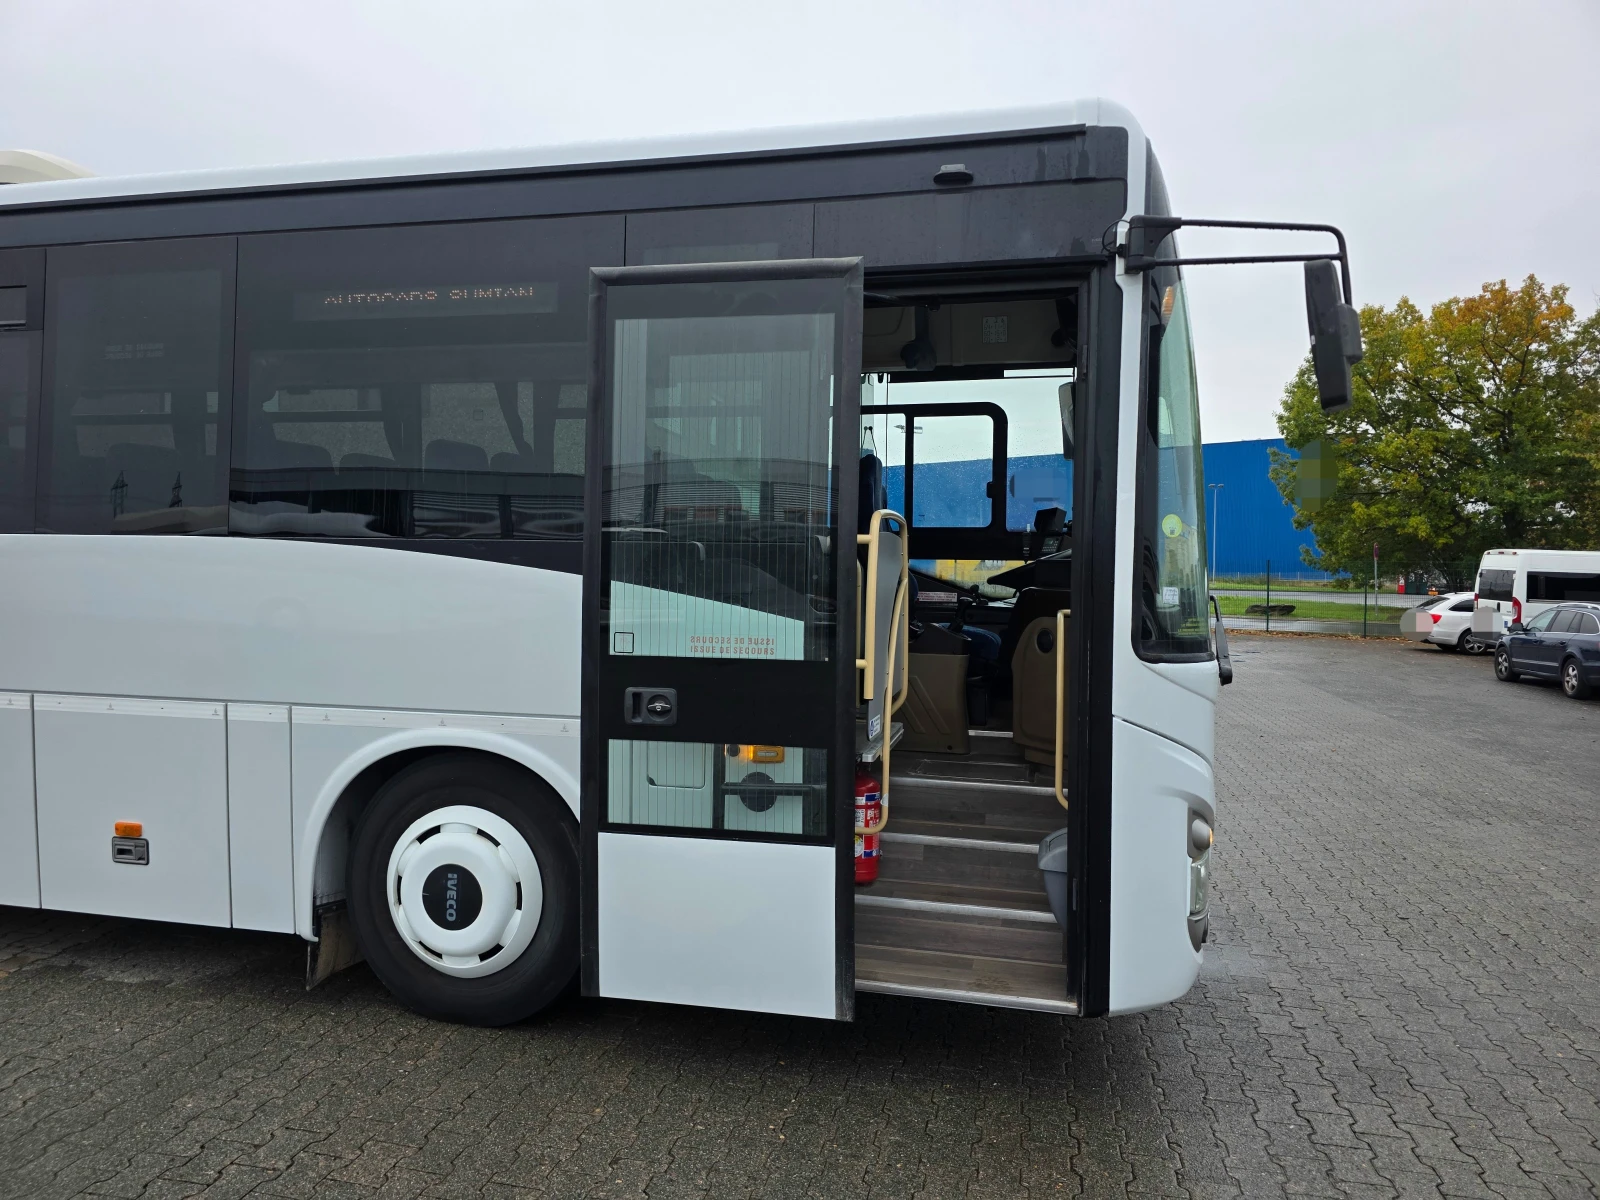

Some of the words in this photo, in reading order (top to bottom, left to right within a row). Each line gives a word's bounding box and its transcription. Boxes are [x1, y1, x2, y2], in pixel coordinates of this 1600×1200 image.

[690, 645, 716, 653] ISSUE
[719, 646, 730, 654] DE
[733, 646, 775, 655] SECOURS
[446, 873, 457, 922] IVECO
